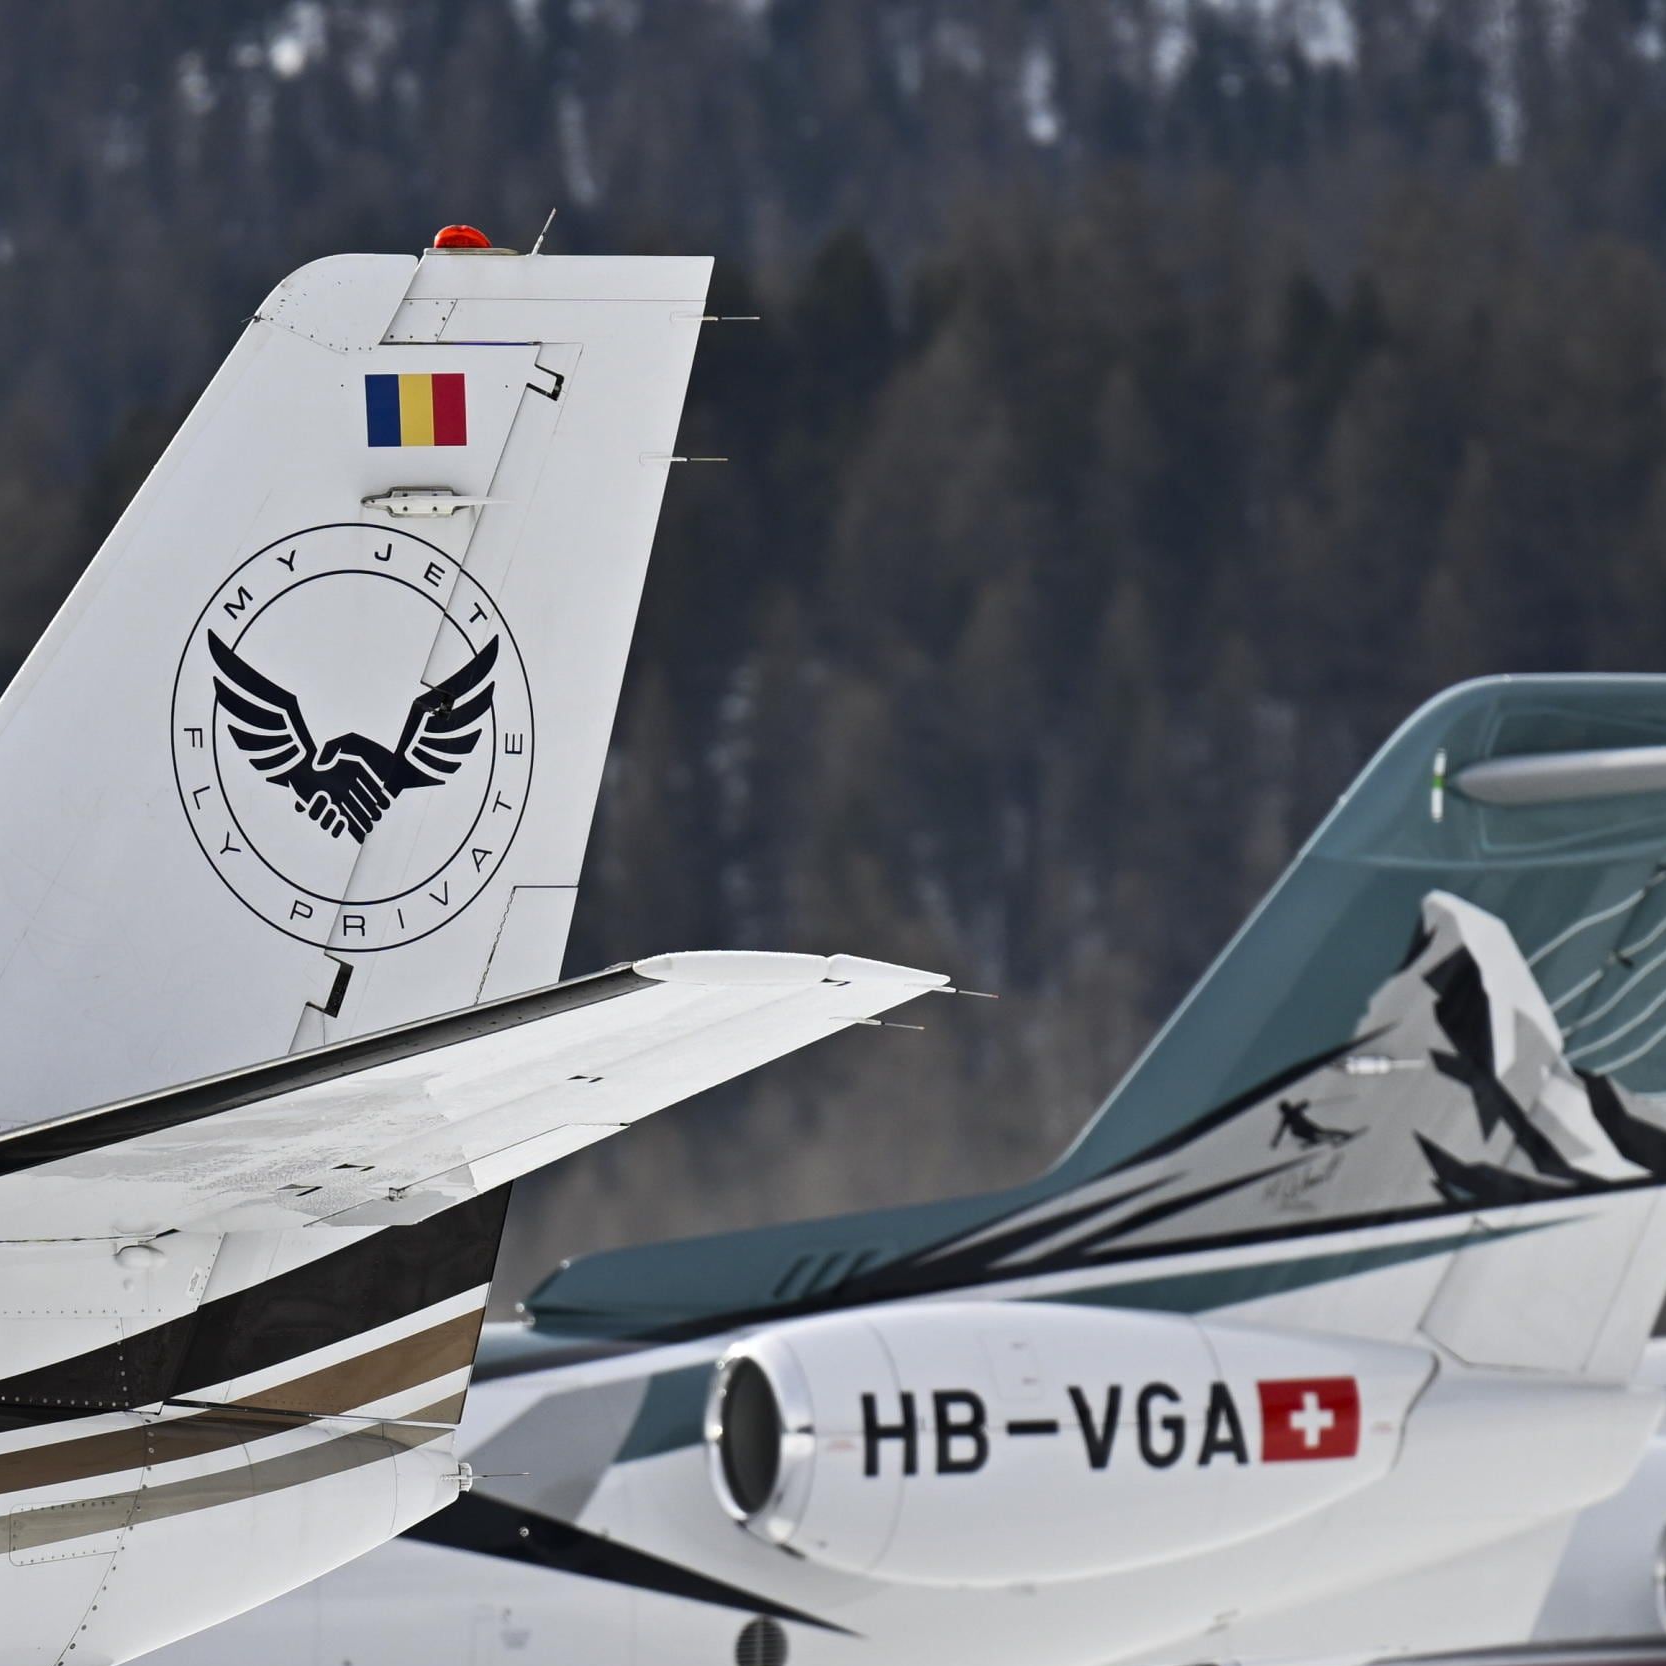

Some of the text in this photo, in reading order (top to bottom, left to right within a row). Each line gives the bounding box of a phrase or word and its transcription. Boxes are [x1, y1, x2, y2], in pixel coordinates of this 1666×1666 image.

[223, 543, 488, 624] MY JET
[183, 727, 523, 937] FLY PRIVATE
[861, 1382, 1248, 1477] HB-VGA
